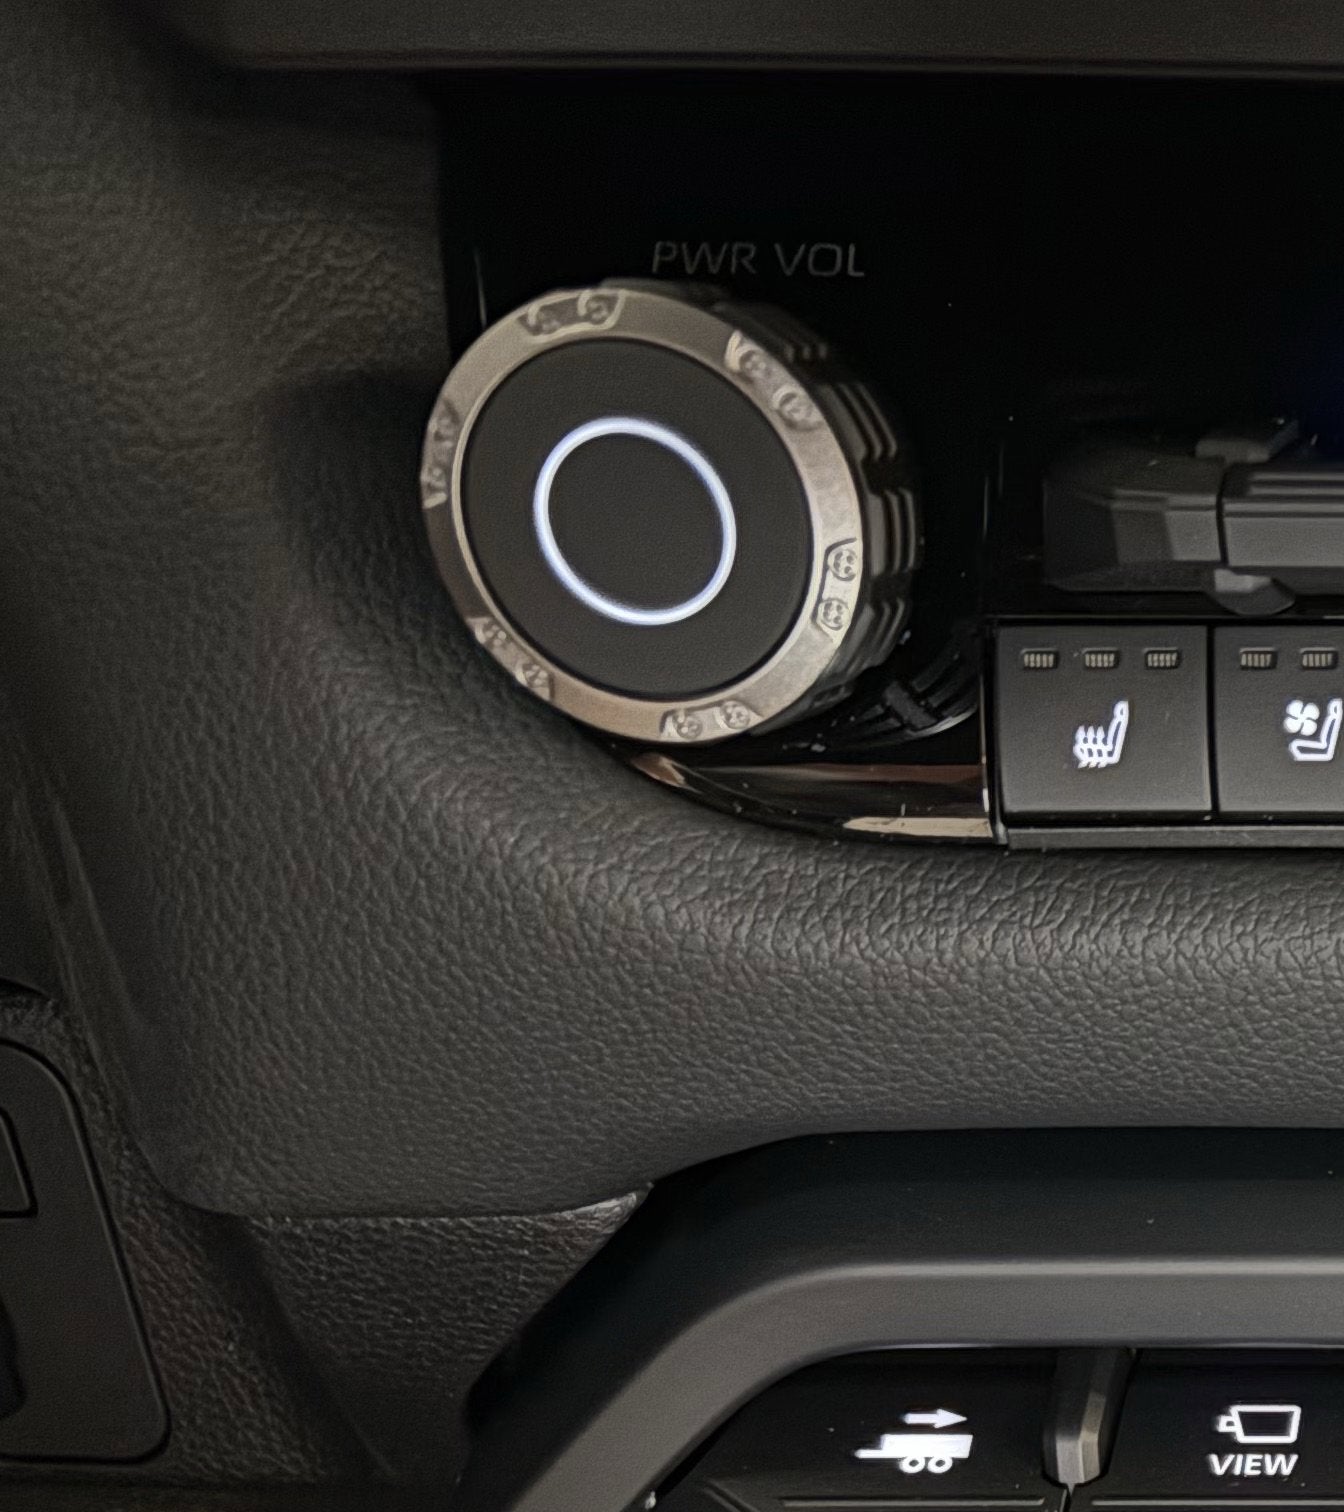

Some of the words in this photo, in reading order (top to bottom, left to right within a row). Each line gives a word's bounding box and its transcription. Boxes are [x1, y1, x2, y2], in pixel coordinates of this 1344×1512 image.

[652, 241, 754, 275] PWR
[775, 242, 866, 278] VOL
[1207, 1453, 1299, 1477] VIEW
